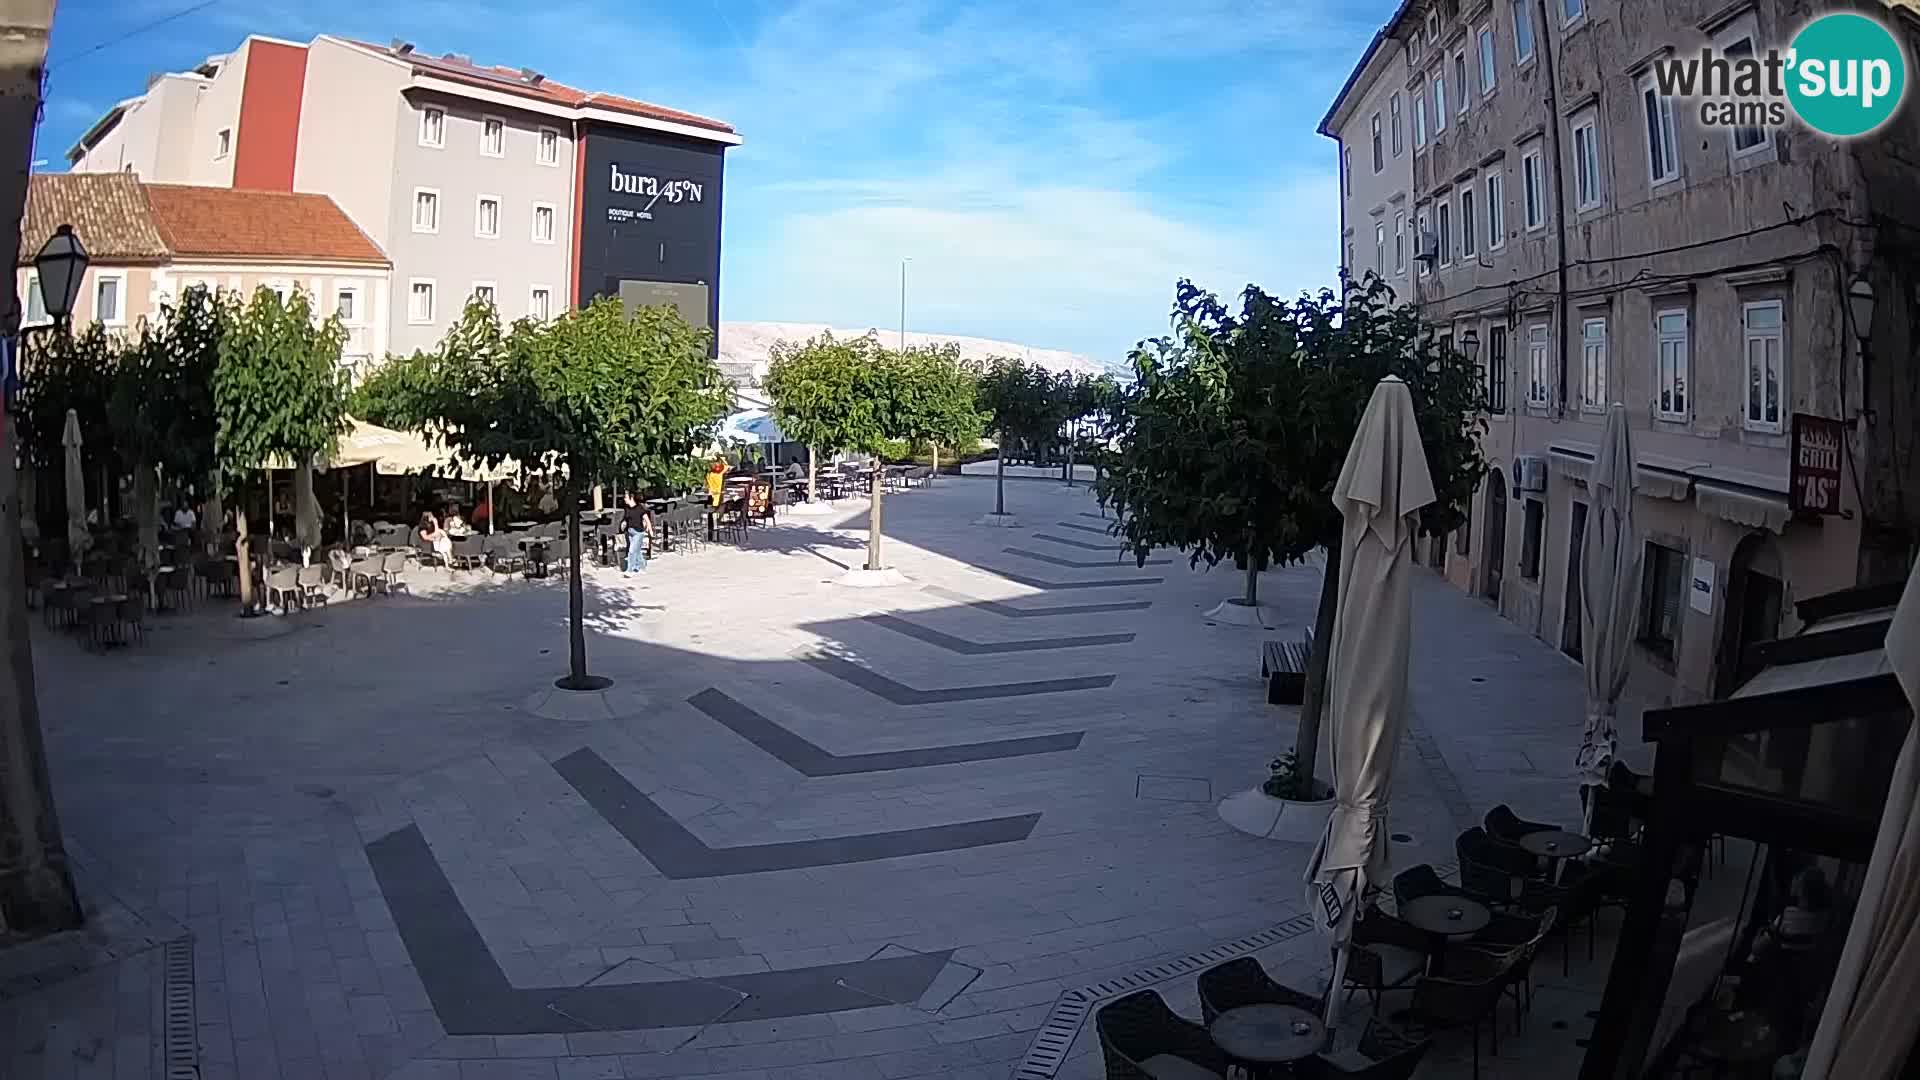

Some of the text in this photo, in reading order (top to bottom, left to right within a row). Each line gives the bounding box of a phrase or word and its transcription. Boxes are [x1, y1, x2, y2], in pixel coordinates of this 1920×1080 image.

[608, 208, 653, 220] BOUTIQUE HOTEL
[1799, 447, 1838, 471] GRILL
